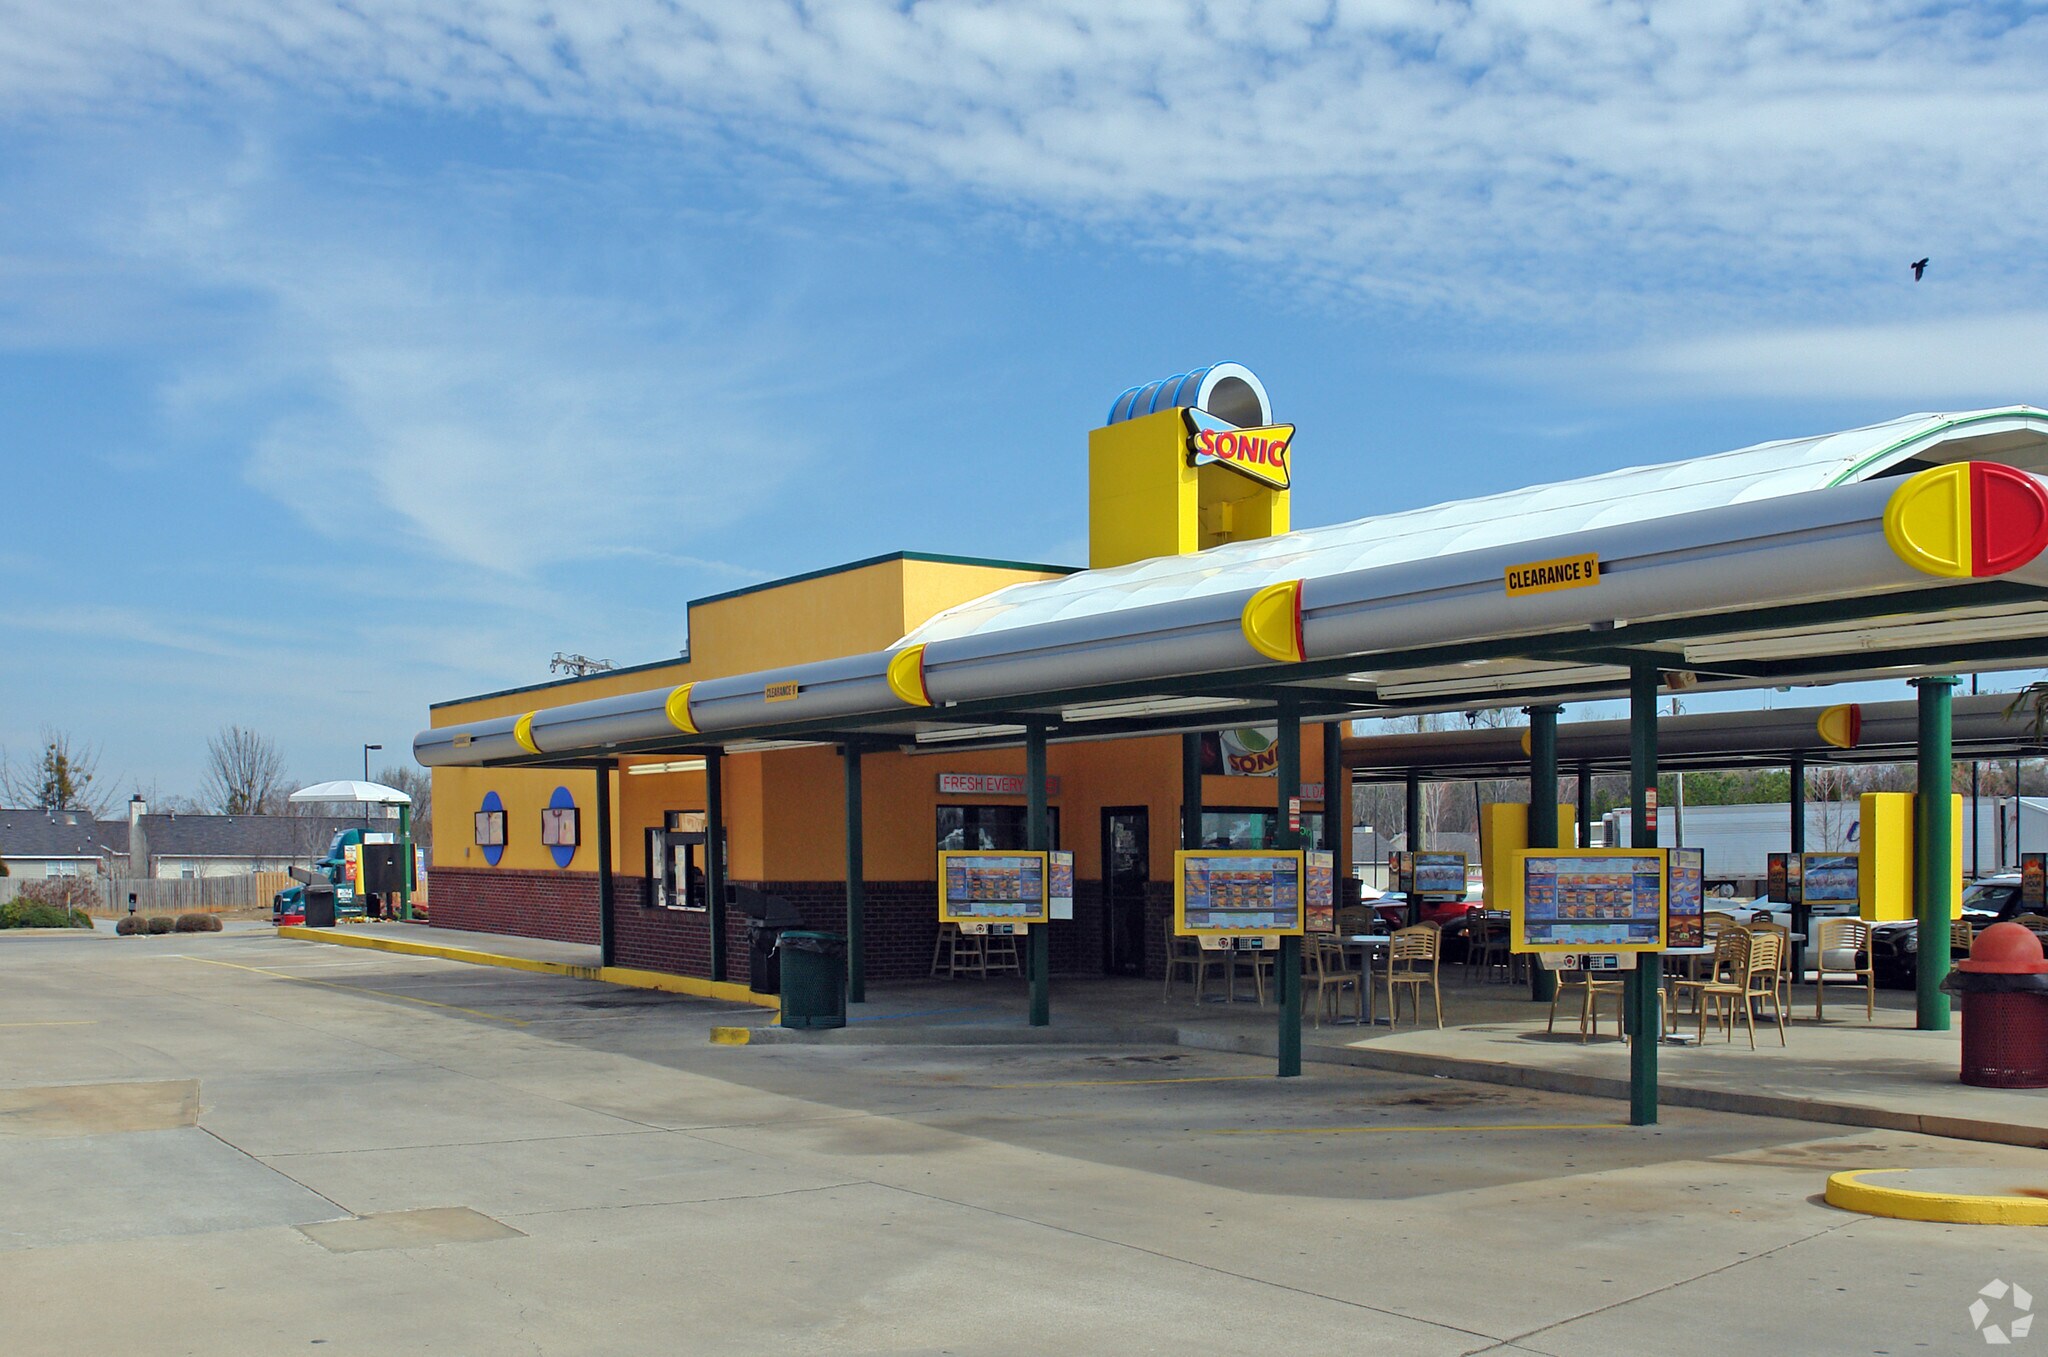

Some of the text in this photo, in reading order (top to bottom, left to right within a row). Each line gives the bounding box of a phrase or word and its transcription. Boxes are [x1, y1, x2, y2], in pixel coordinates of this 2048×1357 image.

[1199, 429, 1286, 467] SONIC
[1509, 560, 1594, 590] CLEARANCE 9'
[1228, 744, 1278, 772] SONI
[943, 776, 1024, 792] FRESH EVERY
